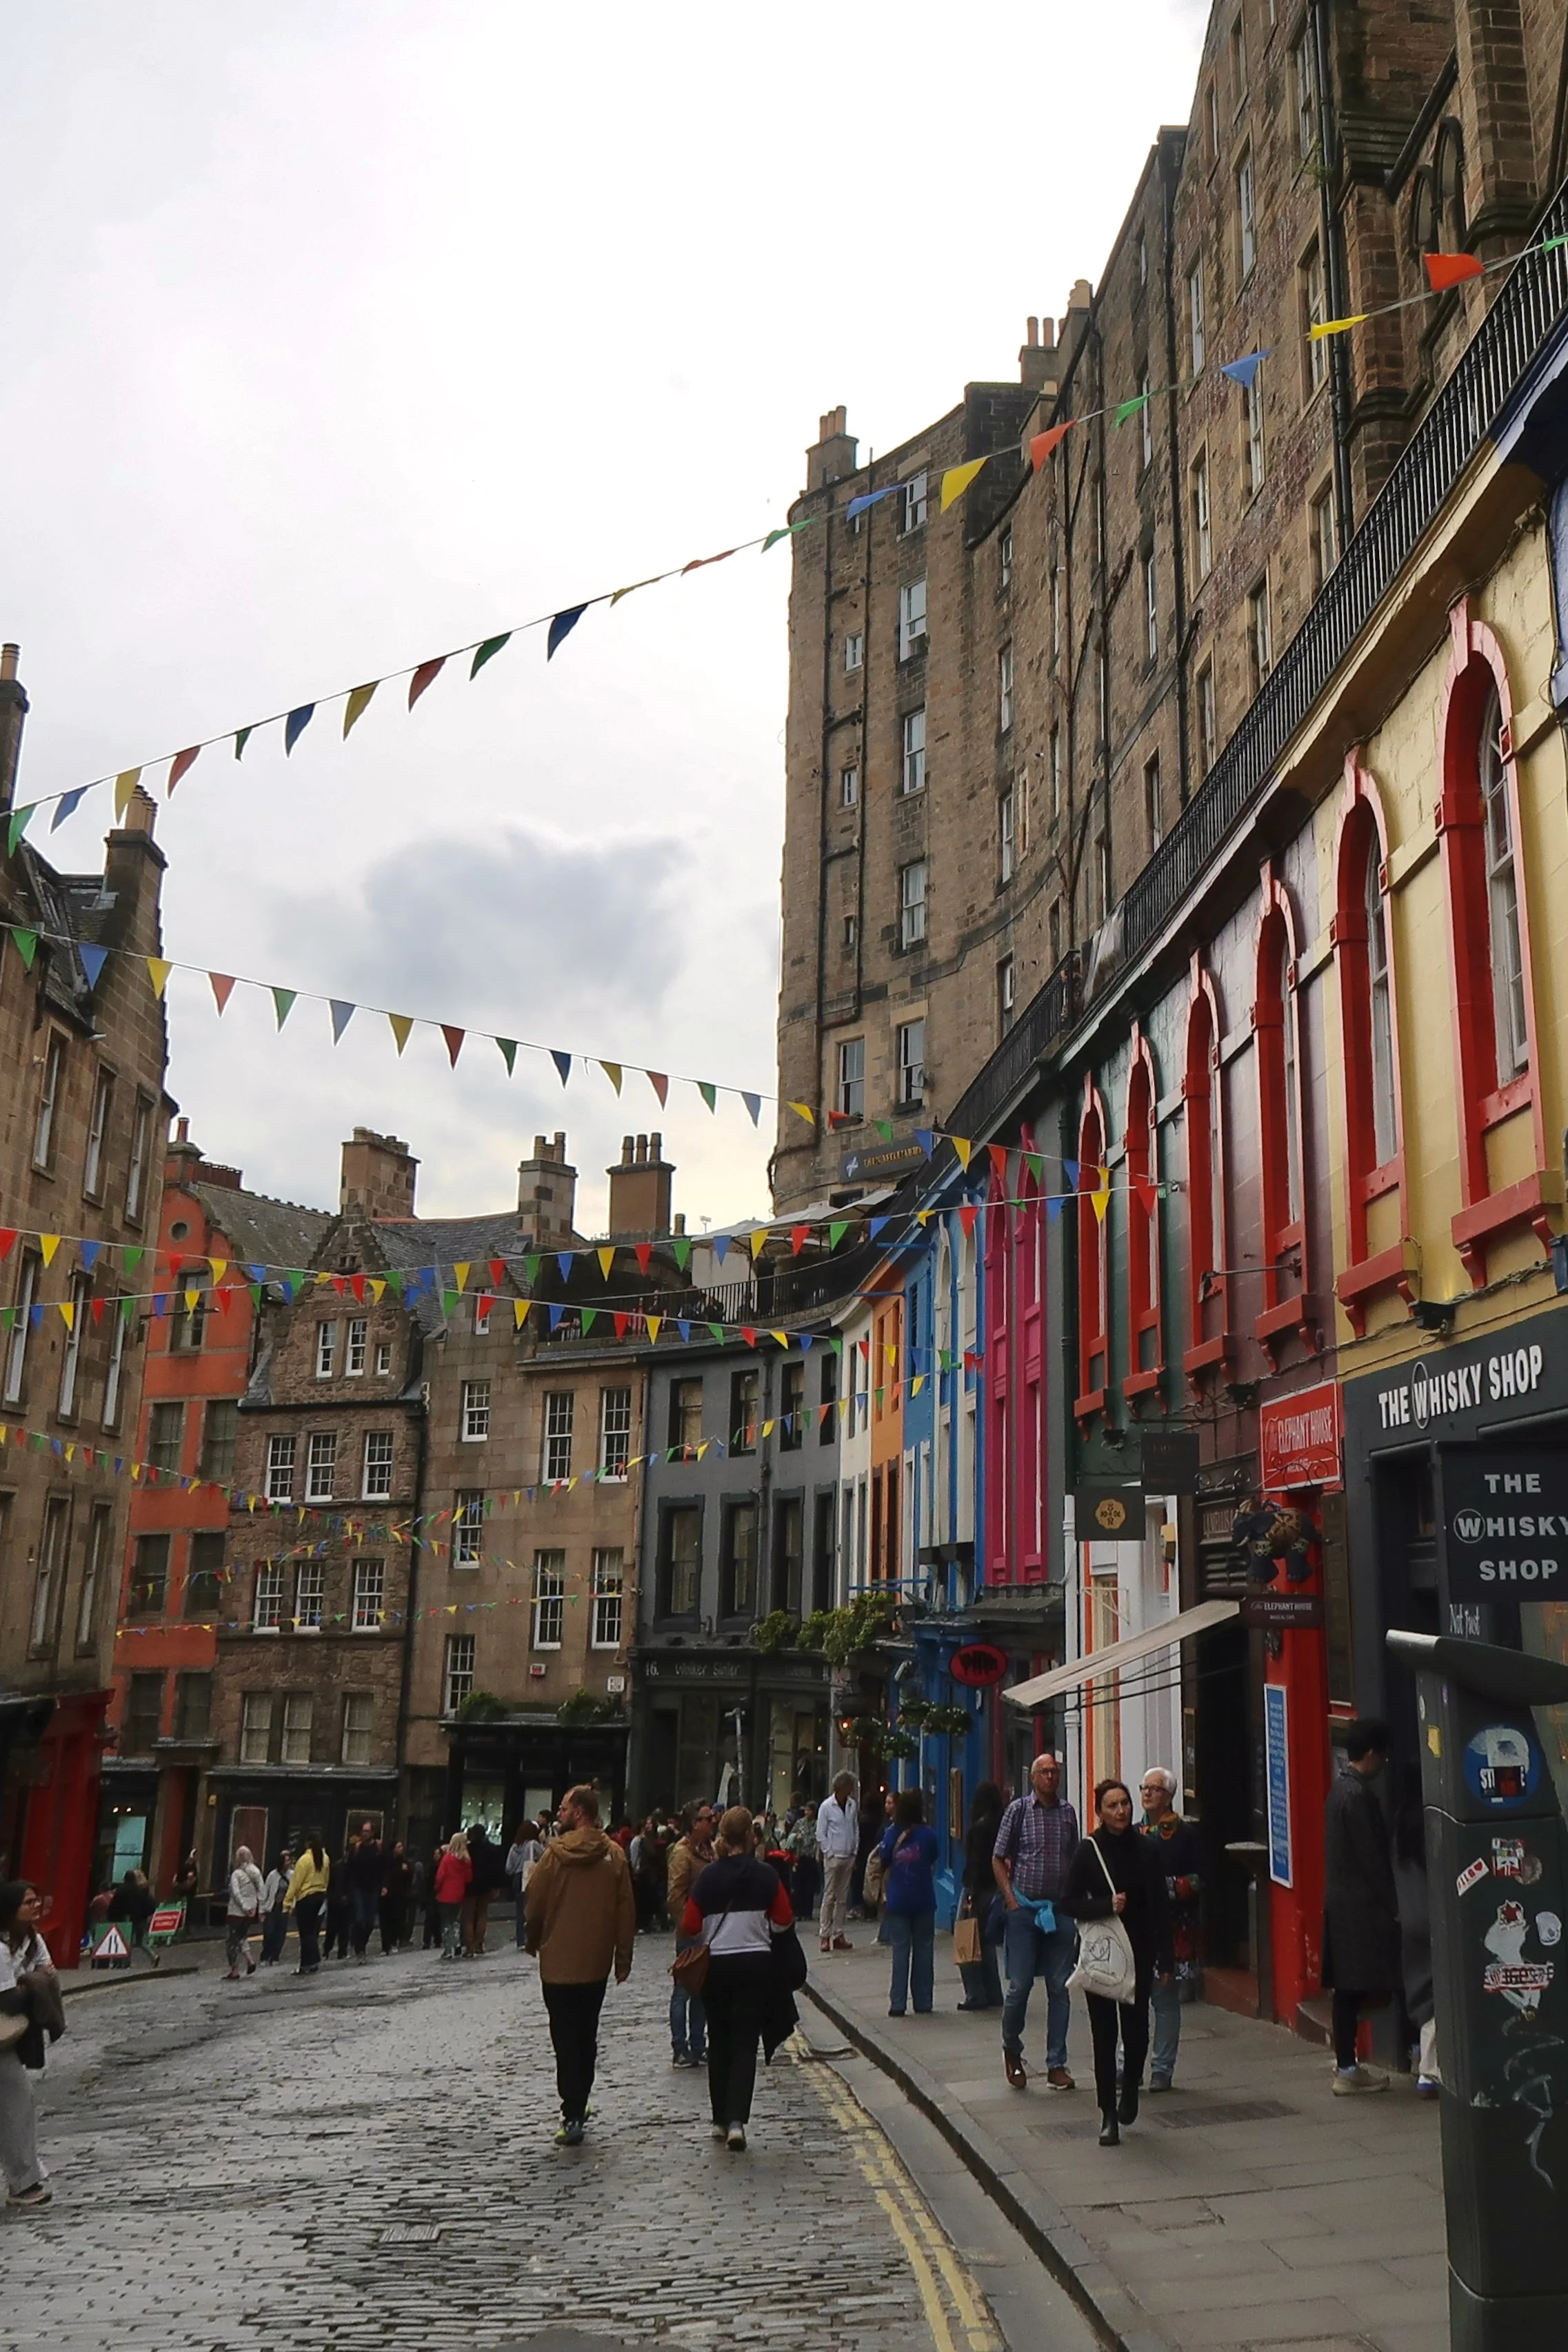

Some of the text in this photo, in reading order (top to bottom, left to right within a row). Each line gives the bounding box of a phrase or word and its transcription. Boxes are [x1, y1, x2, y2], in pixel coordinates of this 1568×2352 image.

[1378, 1345, 1542, 1429] THE WHISKY SHOP
[1278, 1412, 1309, 1454] ELEPHANT
[1310, 1405, 1334, 1446] HOUSE
[1484, 1474, 1542, 1494] THE
[1479, 1559, 1558, 1581] SHOP
[1264, 1602, 1294, 1611] ELEPHANT
[1294, 1602, 1312, 1611] HOUSE
